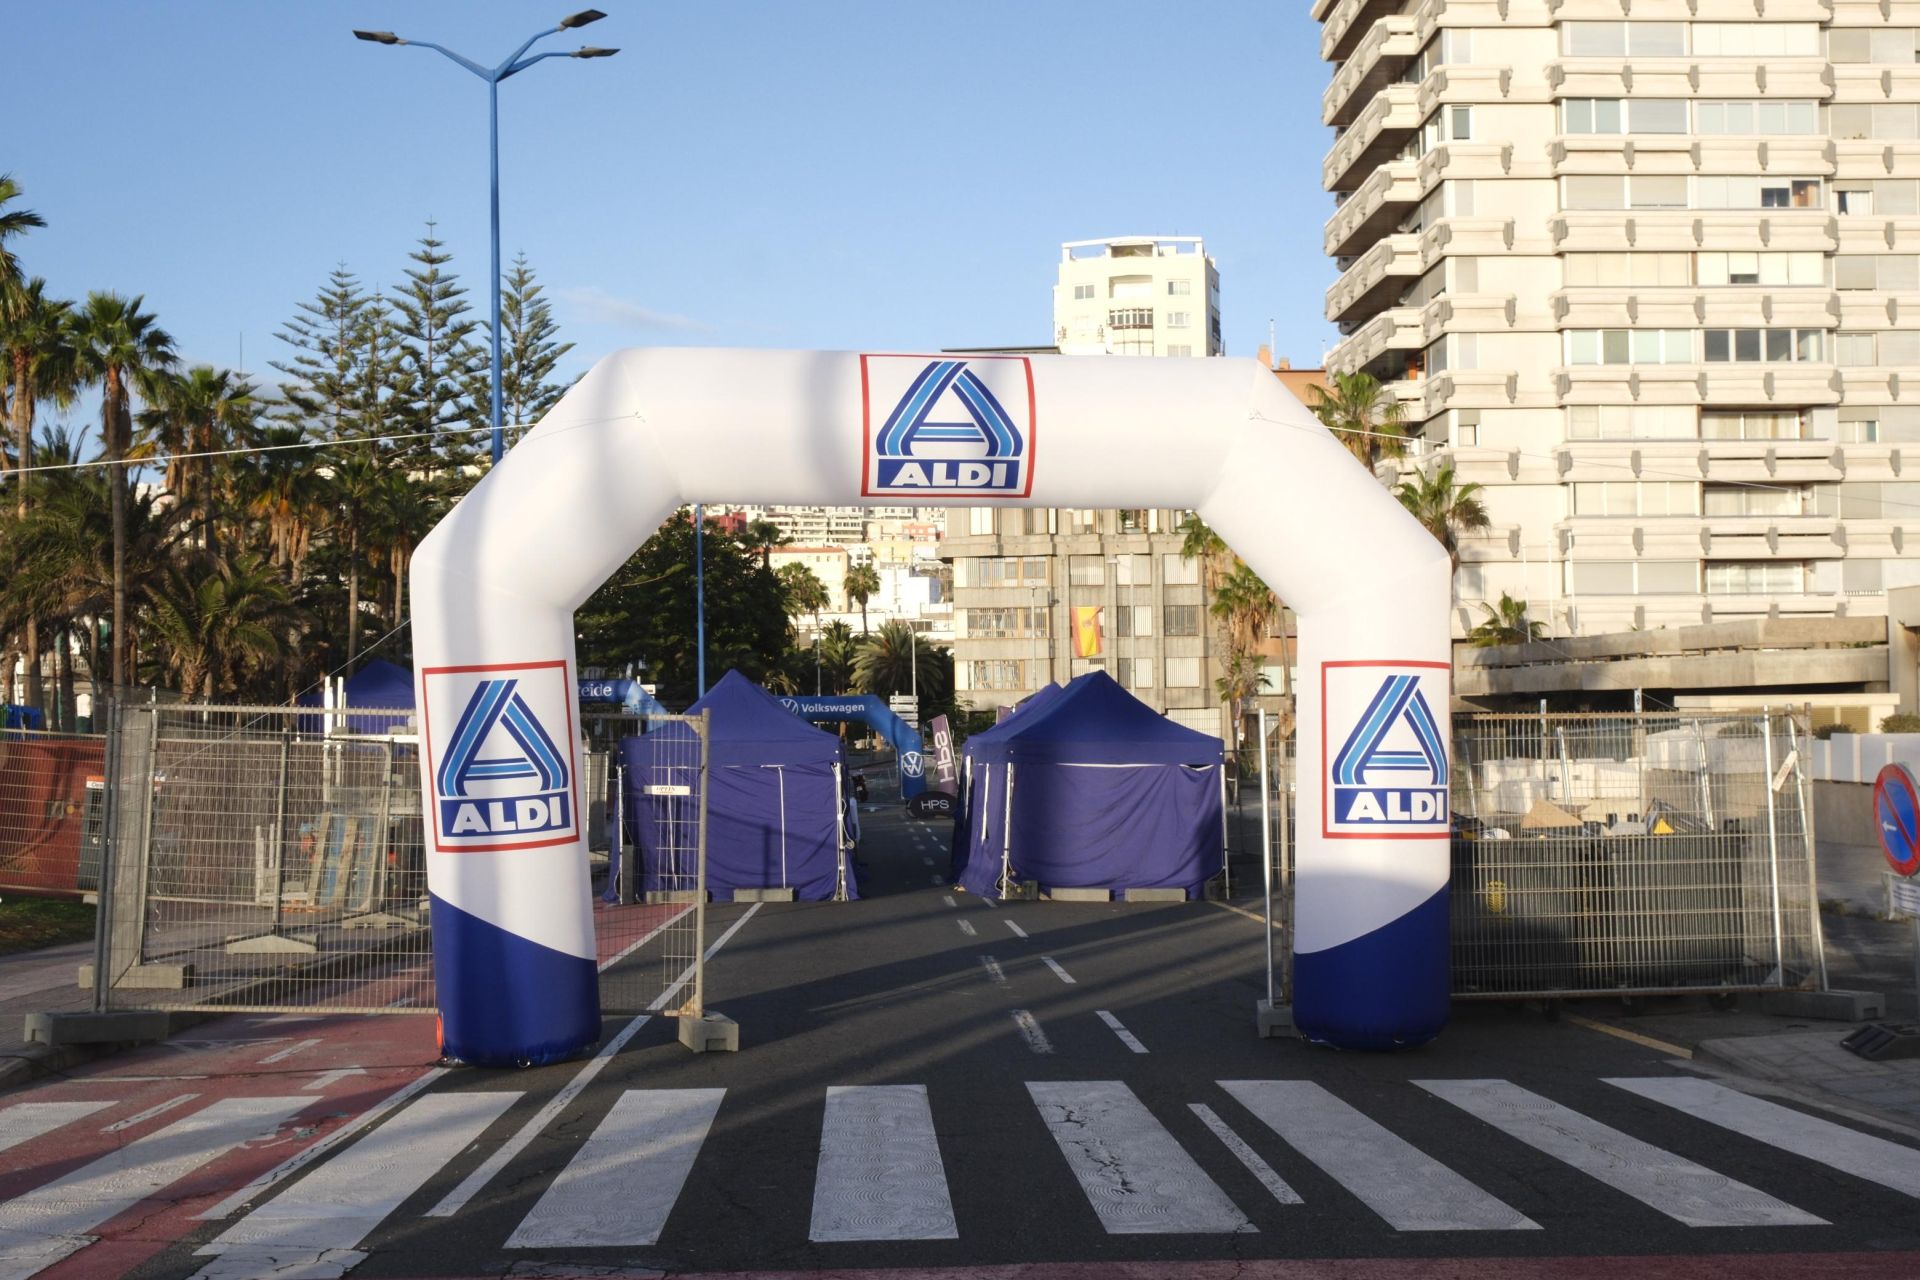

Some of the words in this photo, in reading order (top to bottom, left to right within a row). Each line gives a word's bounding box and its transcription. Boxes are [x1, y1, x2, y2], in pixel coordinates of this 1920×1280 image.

[890, 463, 1007, 487] ALDI
[801, 703, 865, 714] Volkswagen
[451, 796, 562, 833] ALDI
[920, 800, 950, 810] HPS
[1346, 791, 1444, 821] ALDI
